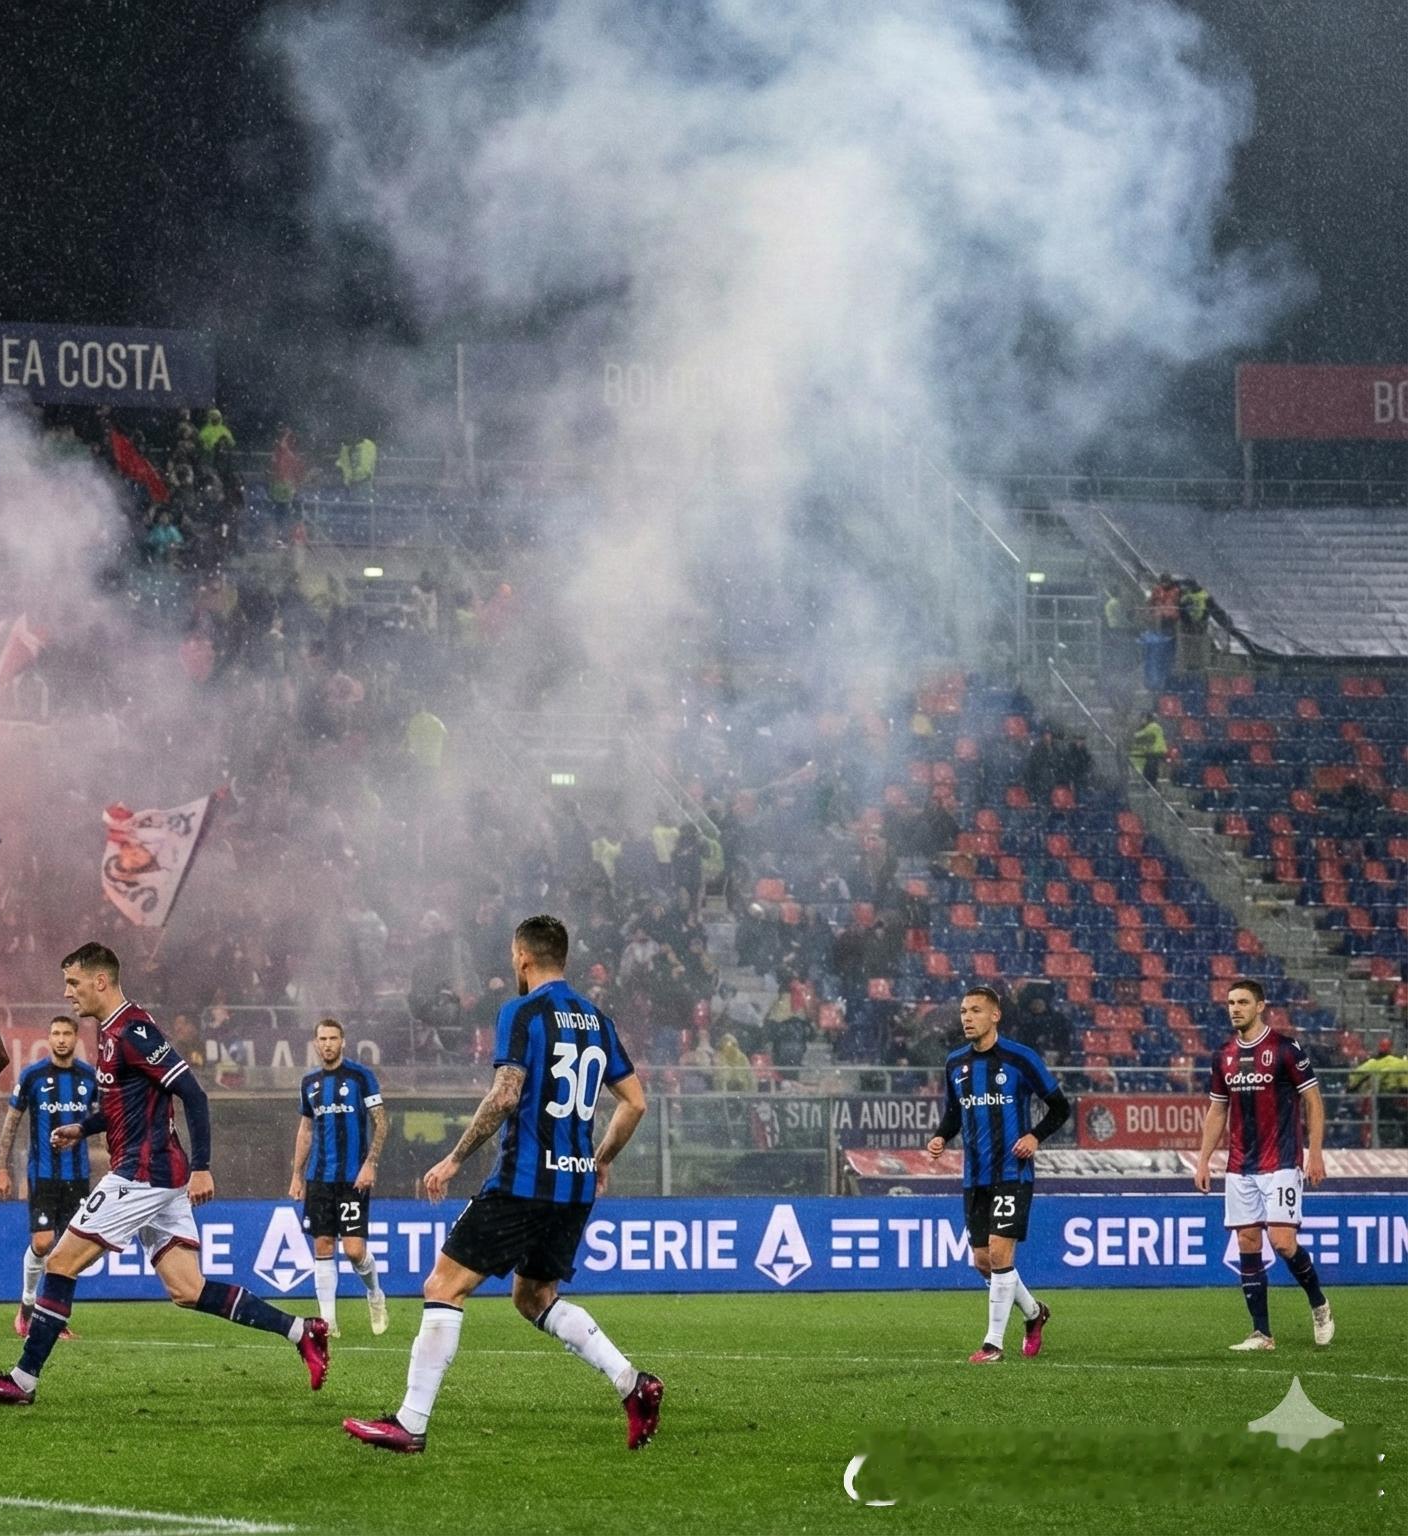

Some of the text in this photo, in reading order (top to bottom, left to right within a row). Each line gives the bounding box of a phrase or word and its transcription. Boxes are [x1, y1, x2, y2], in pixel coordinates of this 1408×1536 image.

[57, 341, 172, 392] COSTA
[545, 1042, 607, 1121] 30
[859, 1101, 940, 1129] ANDREA
[545, 1150, 598, 1173] Lenov
[993, 1195, 1016, 1217] 23
[1278, 1187, 1296, 1207] 19
[584, 1219, 738, 1271] SERIE
[888, 1219, 976, 1268] TIM
[1062, 1216, 1207, 1267] SERIE
